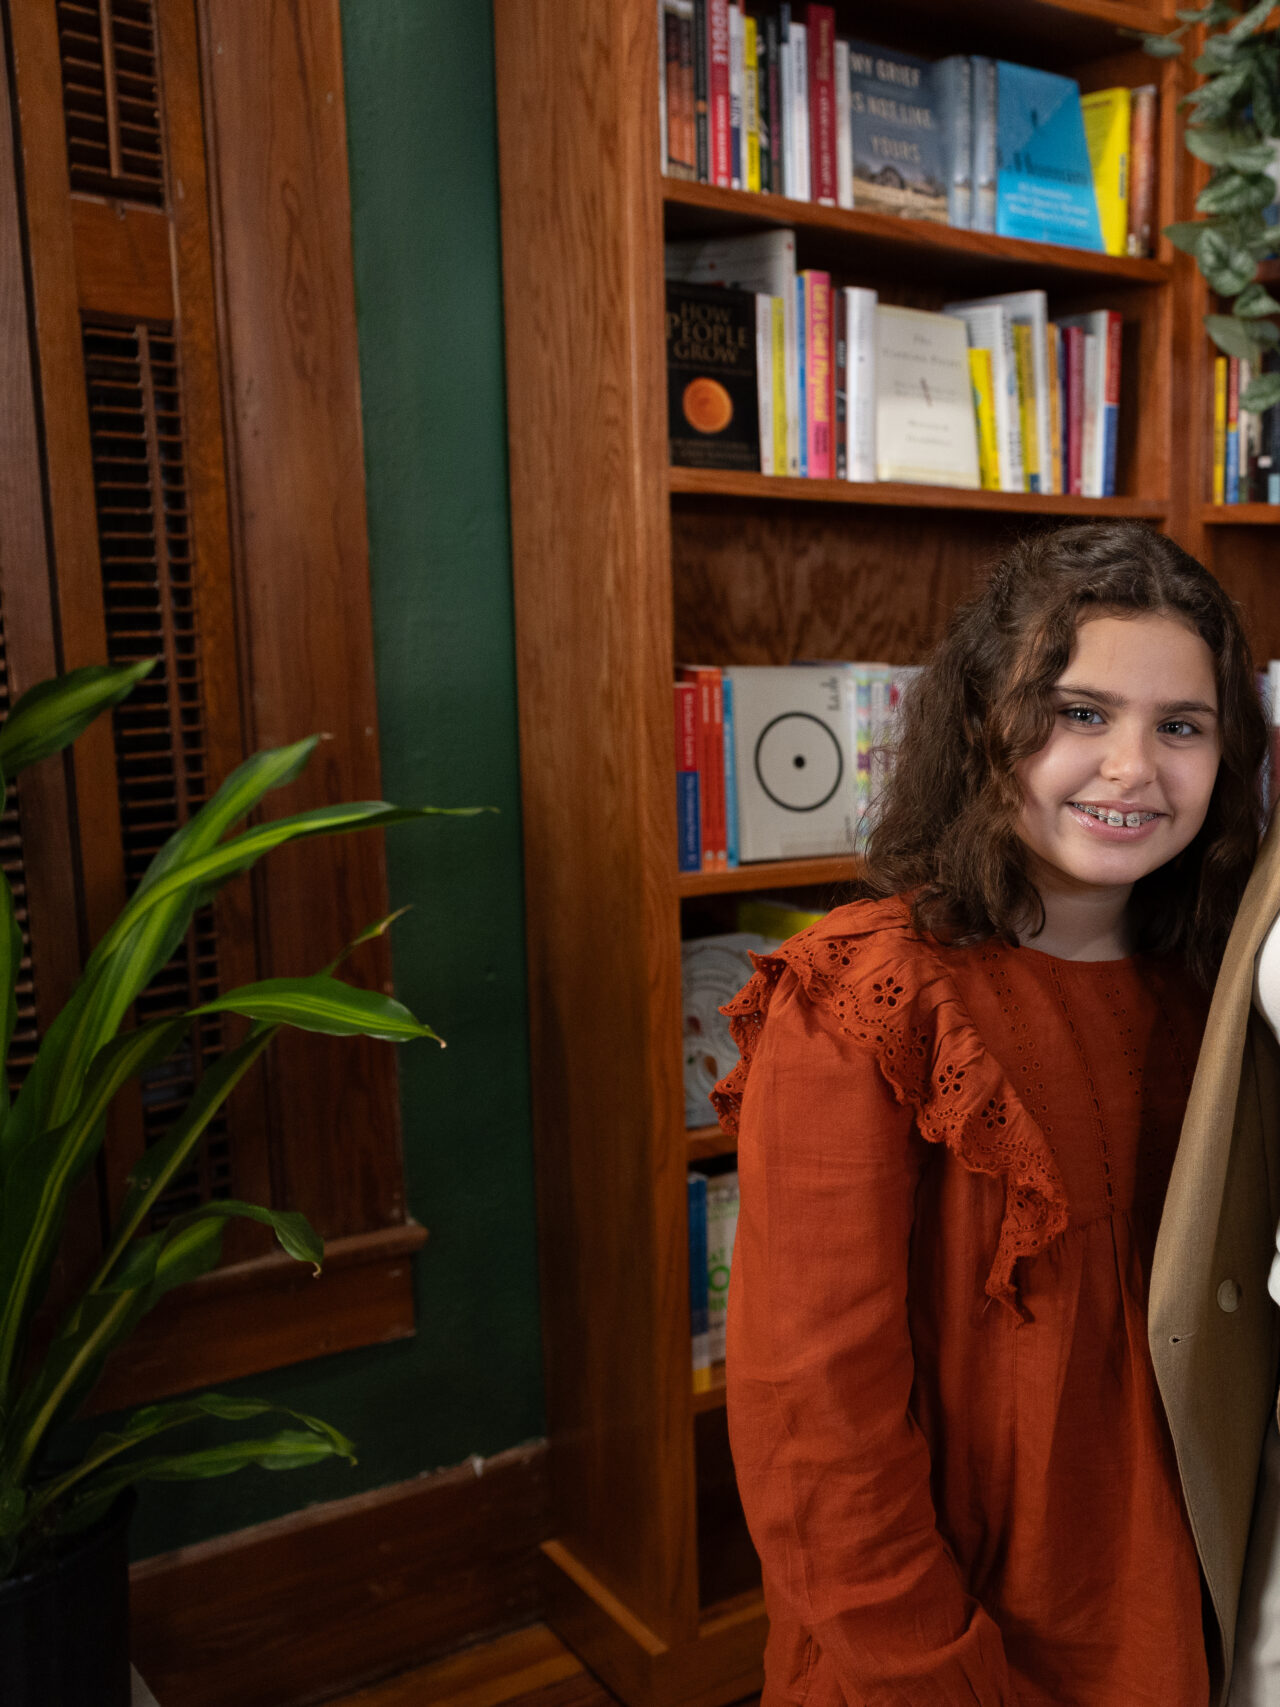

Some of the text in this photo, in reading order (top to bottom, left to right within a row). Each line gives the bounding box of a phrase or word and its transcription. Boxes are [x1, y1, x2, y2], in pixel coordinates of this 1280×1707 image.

[876, 58, 920, 89] GRIEF
[899, 103, 932, 130] LIKE
[871, 135, 921, 164] YOURS
[681, 302, 730, 325] HOW
[666, 311, 747, 350] PEOPLE
[673, 340, 738, 365] GROW
